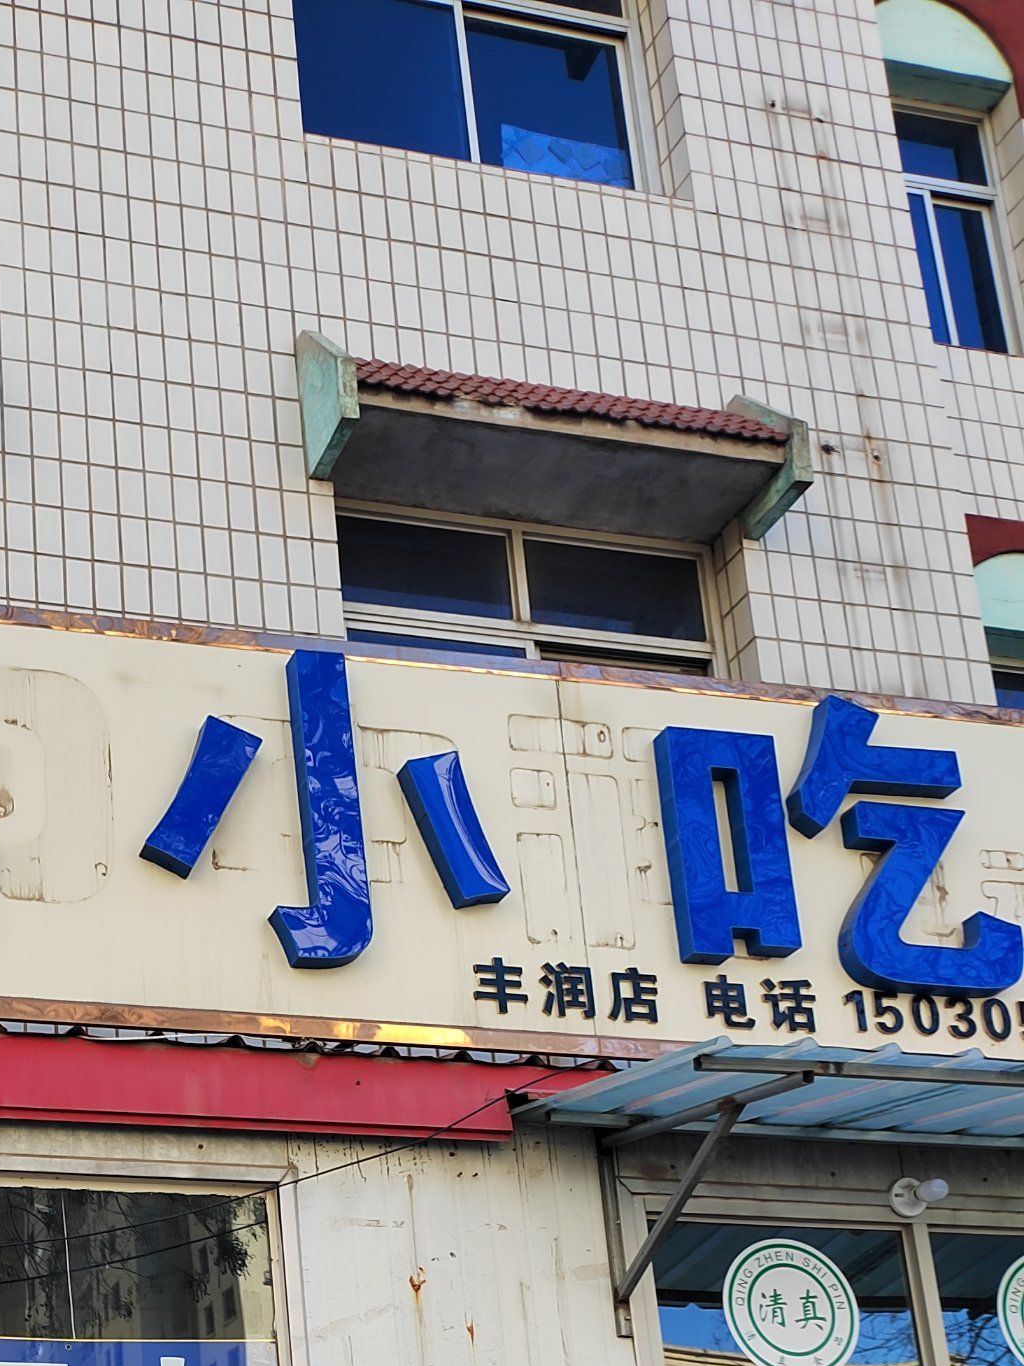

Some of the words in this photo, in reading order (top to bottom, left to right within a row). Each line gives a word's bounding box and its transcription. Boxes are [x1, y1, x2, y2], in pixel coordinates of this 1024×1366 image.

[473, 957, 659, 1024] 丰润店
[703, 974, 816, 1033] 电话
[843, 989, 1024, 1042] 15030
[736, 1268, 754, 1307] QING
[753, 1251, 795, 1268] ZHEN
[801, 1257, 828, 1279] SHI
[828, 1283, 846, 1311] PIN
[759, 1288, 827, 1331] 清真
